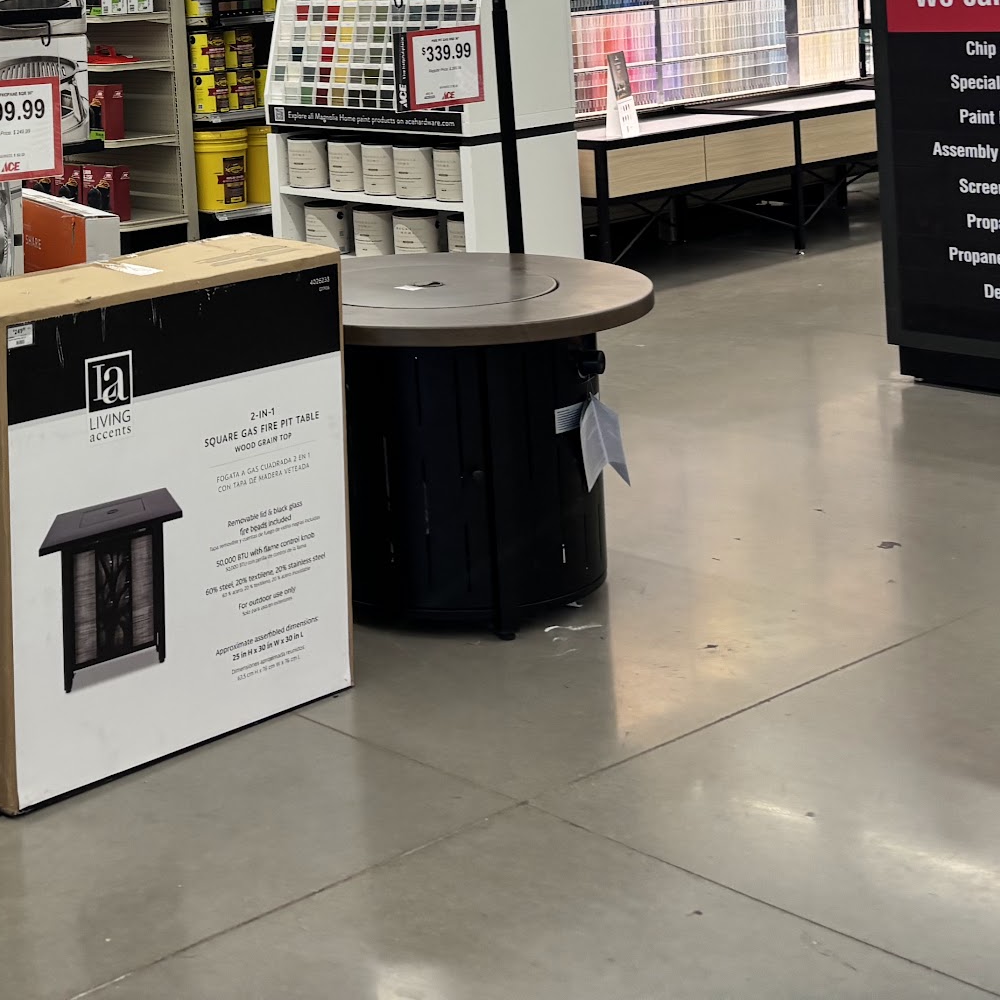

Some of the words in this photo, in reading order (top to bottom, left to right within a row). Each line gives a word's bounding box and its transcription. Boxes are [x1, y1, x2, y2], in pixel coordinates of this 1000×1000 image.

[421, 41, 472, 62] $339.99
[965, 40, 997, 60] Chip
[399, 83, 408, 108] ACE
[441, 91, 456, 100] ACE
[287, 110, 307, 121] Explore
[314, 112, 338, 123] Magnolia
[339, 114, 356, 122] Home
[356, 115, 371, 124] paint
[371, 115, 396, 125] products
[404, 118, 456, 127] acehardware.com
[959, 108, 996, 125] Paint
[932, 141, 999, 163] Assembly
[1, 161, 21, 173] ACE
[958, 177, 1000, 195] Scree
[966, 213, 1000, 233] Prop
[89, 409, 131, 431] LIVING
[250, 407, 276, 421] 2-IN-1
[89, 425, 132, 443] accents
[204, 430, 239, 448] SQUARE
[241, 426, 258, 438] GAS
[260, 421, 278, 434] FIRE
[280, 417, 293, 429] PIT
[295, 410, 320, 424] TABLE
[234, 441, 256, 453] WOOD
[257, 435, 278, 447] GRAIN
[279, 432, 292, 441] TOP
[216, 471, 240, 483] FOGATA
[247, 465, 259, 475] GAS
[260, 456, 292, 471] CUADRADA
[217, 483, 232, 493] CON
[233, 480, 248, 489] TAPA
[258, 470, 283, 482] MADERA
[227, 512, 259, 528] Removable
[273, 504, 288, 515] black
[288, 500, 303, 512] glass
[250, 520, 267, 533] beads
[268, 514, 292, 527] included
[249, 547, 263, 557] with
[263, 542, 280, 553] flame
[280, 535, 300, 548] control
[300, 531, 316, 542] knob
[287, 557, 312, 570] stainless
[248, 594, 273, 607] outdoor
[215, 638, 254, 656] Approximate
[254, 626, 285, 643] assembled
[285, 616, 319, 632] dimensions
[232, 653, 240, 661] 25
